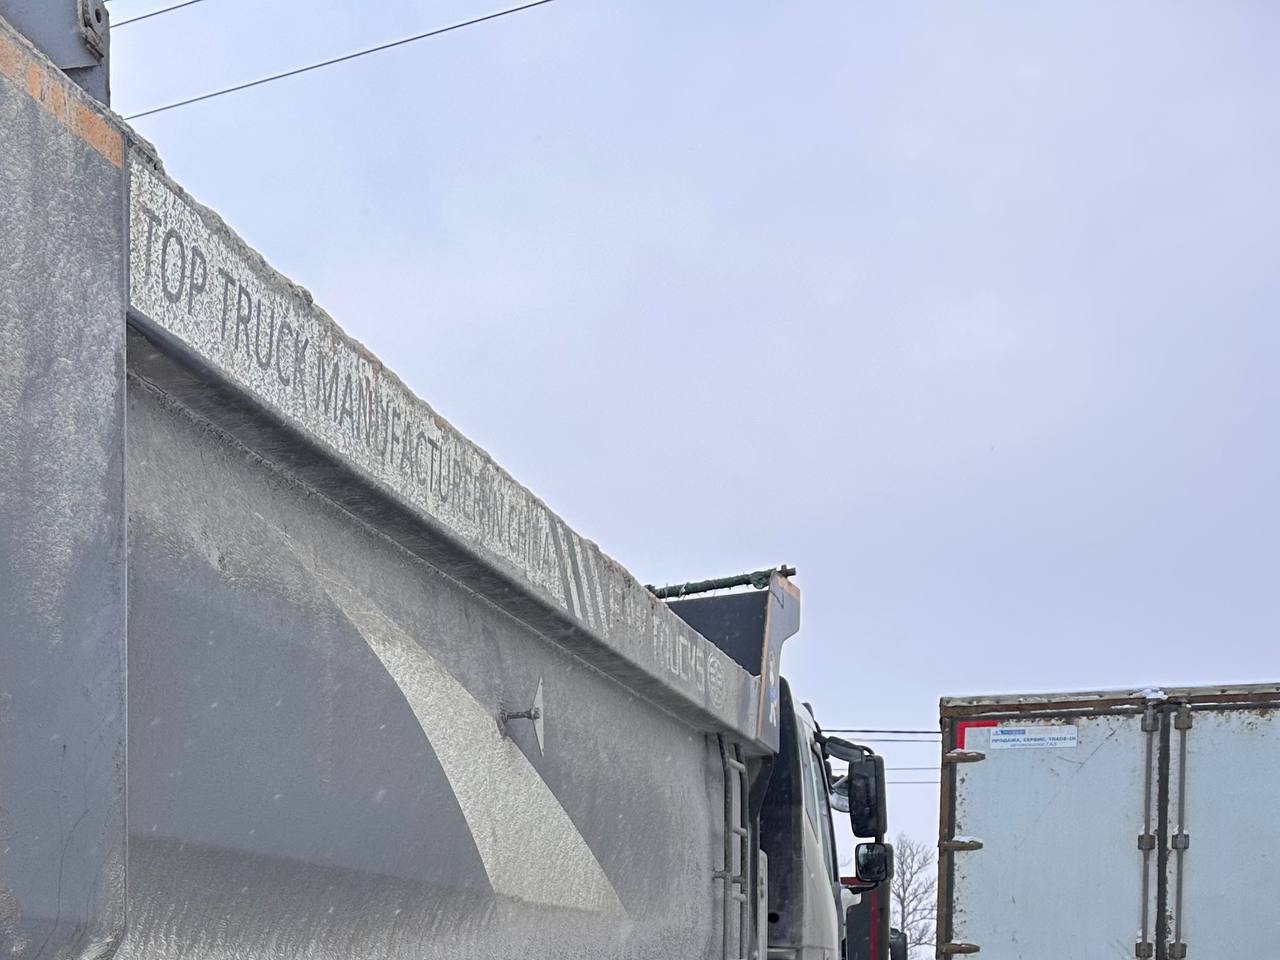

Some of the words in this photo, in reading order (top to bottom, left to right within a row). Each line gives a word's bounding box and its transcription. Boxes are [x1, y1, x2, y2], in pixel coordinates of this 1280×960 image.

[139, 205, 207, 315] TOP
[219, 267, 310, 414] TRUCK
[317, 348, 485, 530] MANUFACTURER
